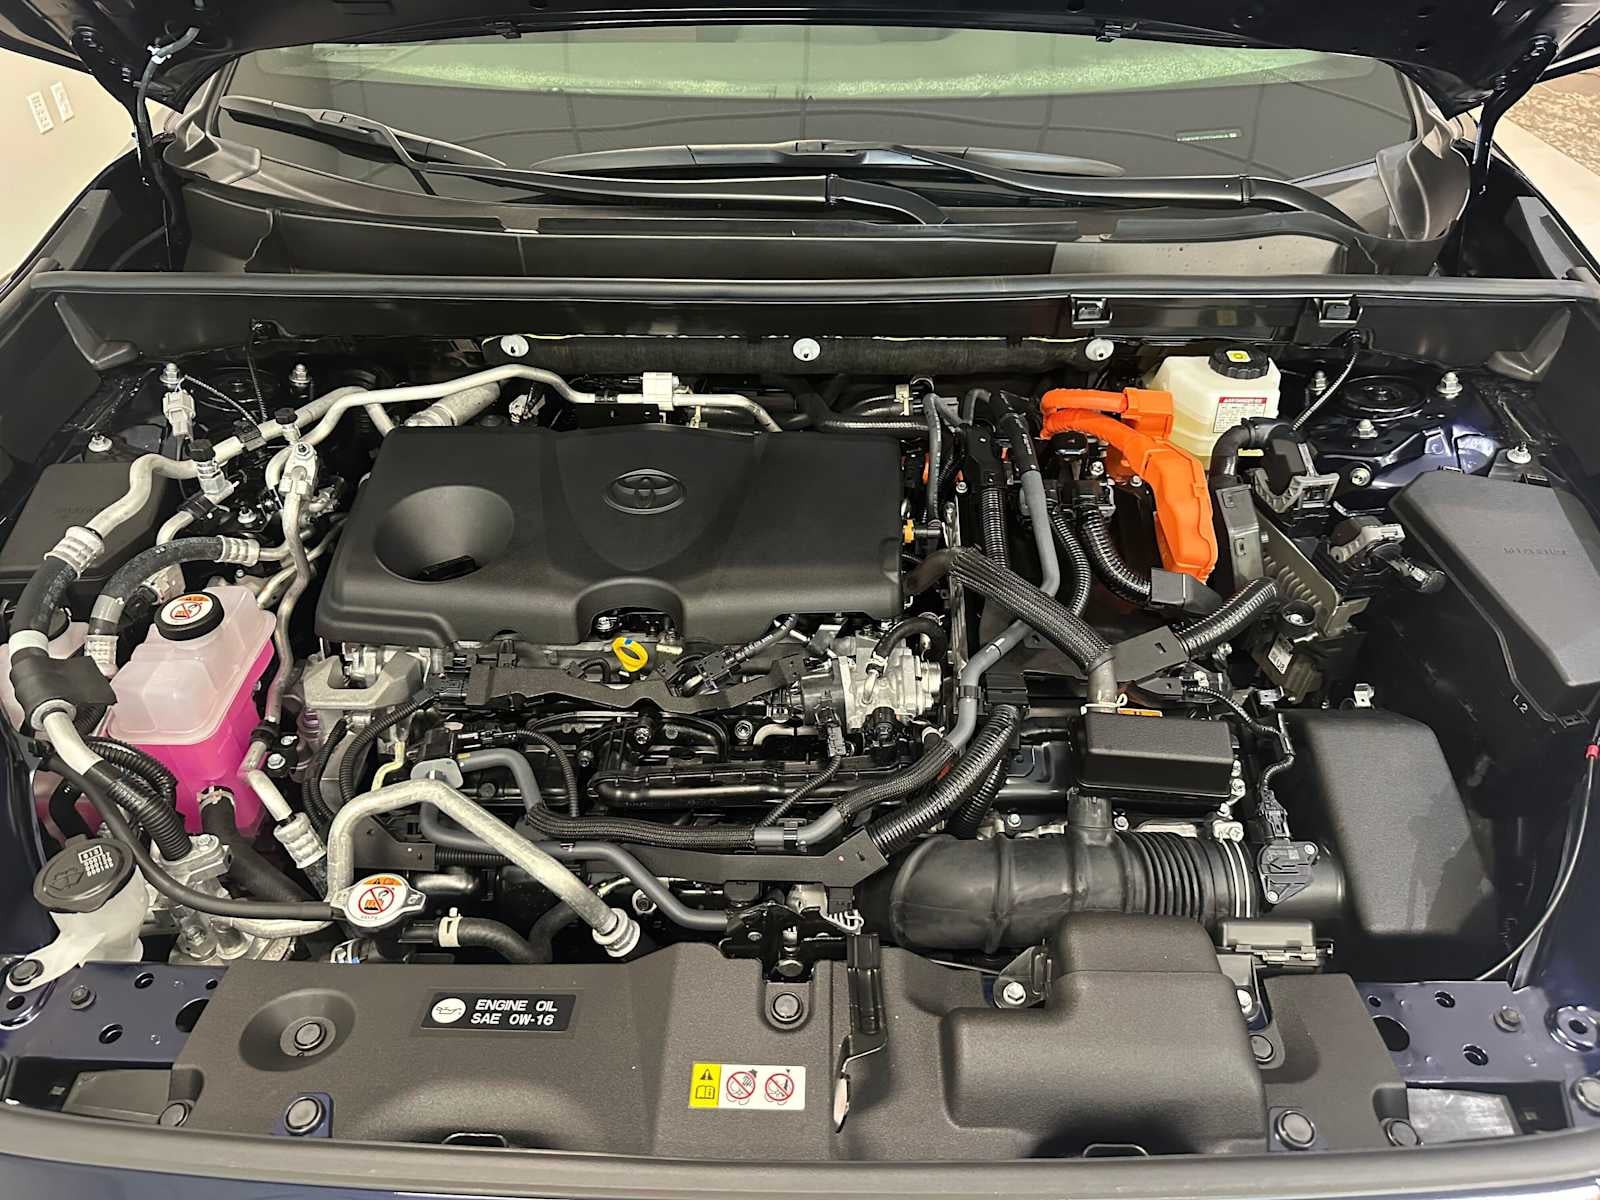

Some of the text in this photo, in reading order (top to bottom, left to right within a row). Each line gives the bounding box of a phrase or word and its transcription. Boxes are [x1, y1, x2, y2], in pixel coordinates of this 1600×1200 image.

[475, 999, 558, 1012] ENGINE OIL
[470, 1013, 501, 1024] SAE
